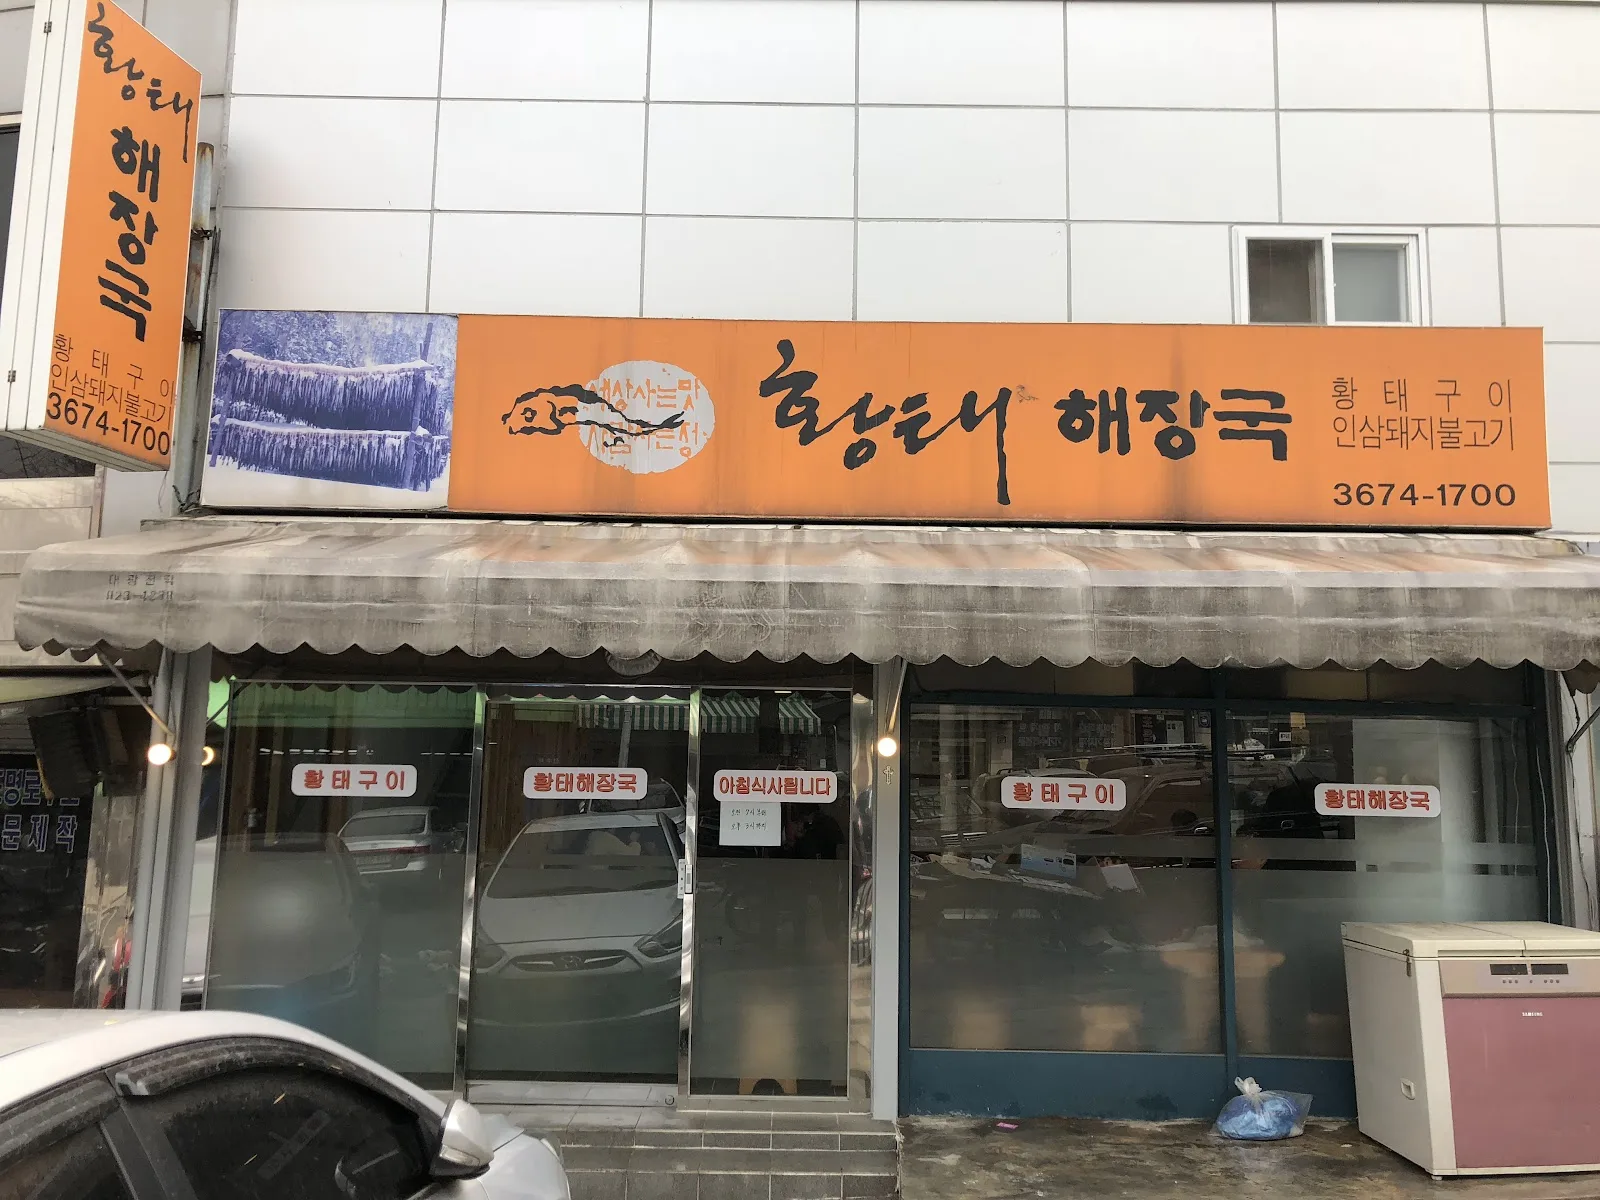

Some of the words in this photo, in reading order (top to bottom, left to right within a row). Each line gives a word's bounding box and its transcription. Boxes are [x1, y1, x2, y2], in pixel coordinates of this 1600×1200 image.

[87, 2, 194, 163] 황태
[97, 125, 161, 342] 해장국
[46, 391, 171, 457] 3674-1700
[50, 362, 173, 432] 인삼돼지불고기
[759, 339, 1012, 505] 황태
[1054, 386, 1293, 461] 해장국
[1333, 414, 1514, 451] 인삼돼지불고기
[1333, 482, 1516, 507] 3674-1700
[533, 772, 638, 794] 황태해장국
[1324, 788, 1431, 811] 황태해장국
